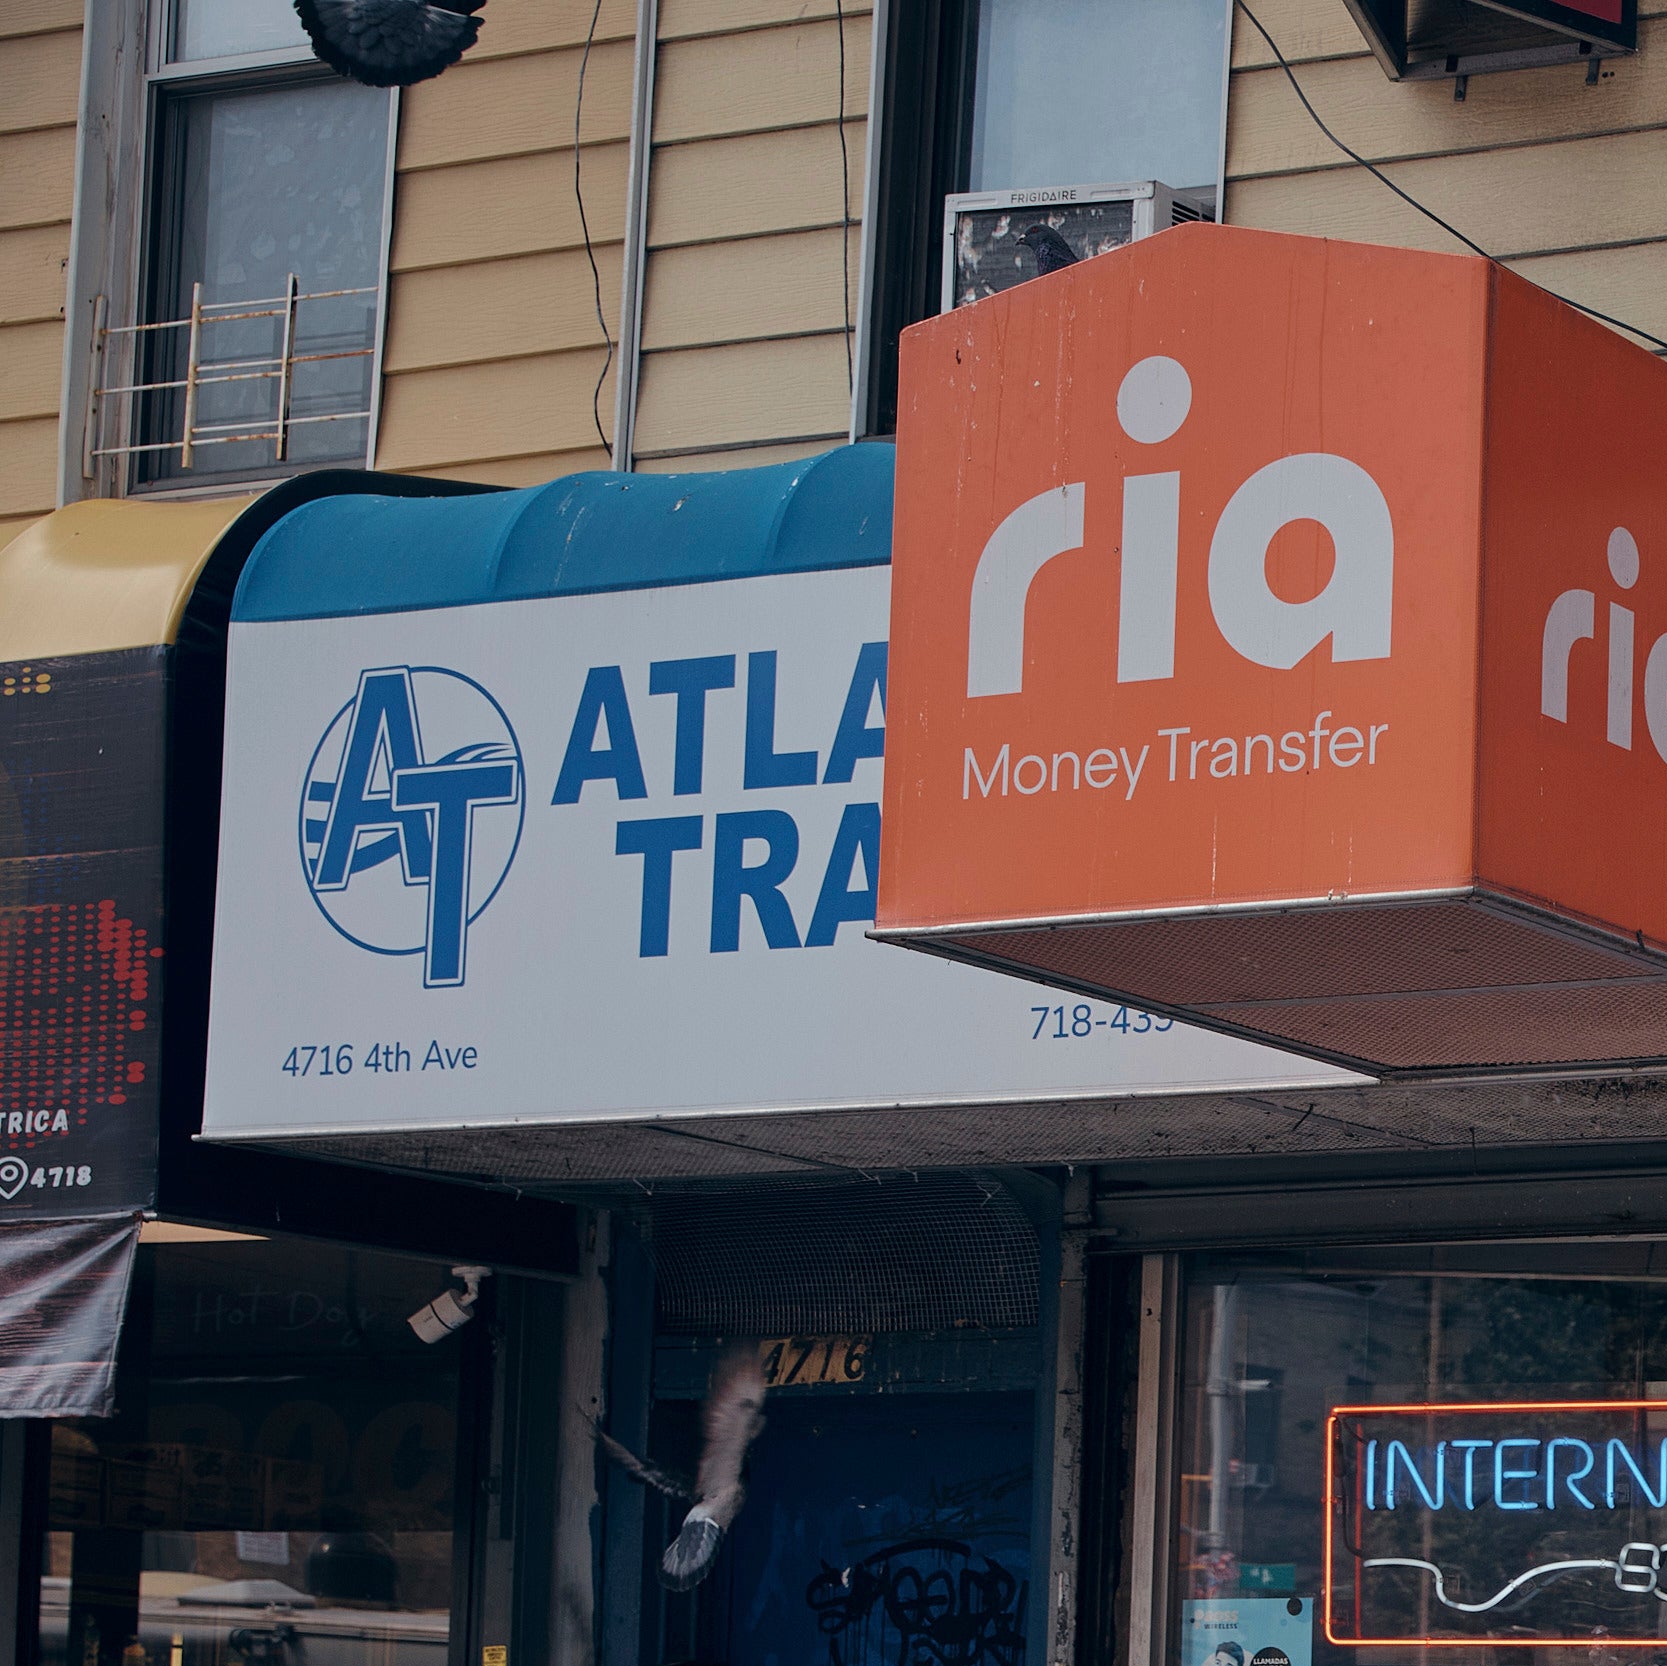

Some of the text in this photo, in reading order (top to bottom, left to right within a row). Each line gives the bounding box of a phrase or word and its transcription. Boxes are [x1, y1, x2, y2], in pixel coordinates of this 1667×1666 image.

[968, 355, 1395, 698] ria
[962, 712, 1389, 800] Money Transfer
[282, 1040, 478, 1077] 4716 4th Ave
[31, 1166, 92, 1188] 4718
[762, 1338, 866, 1383] 4716
